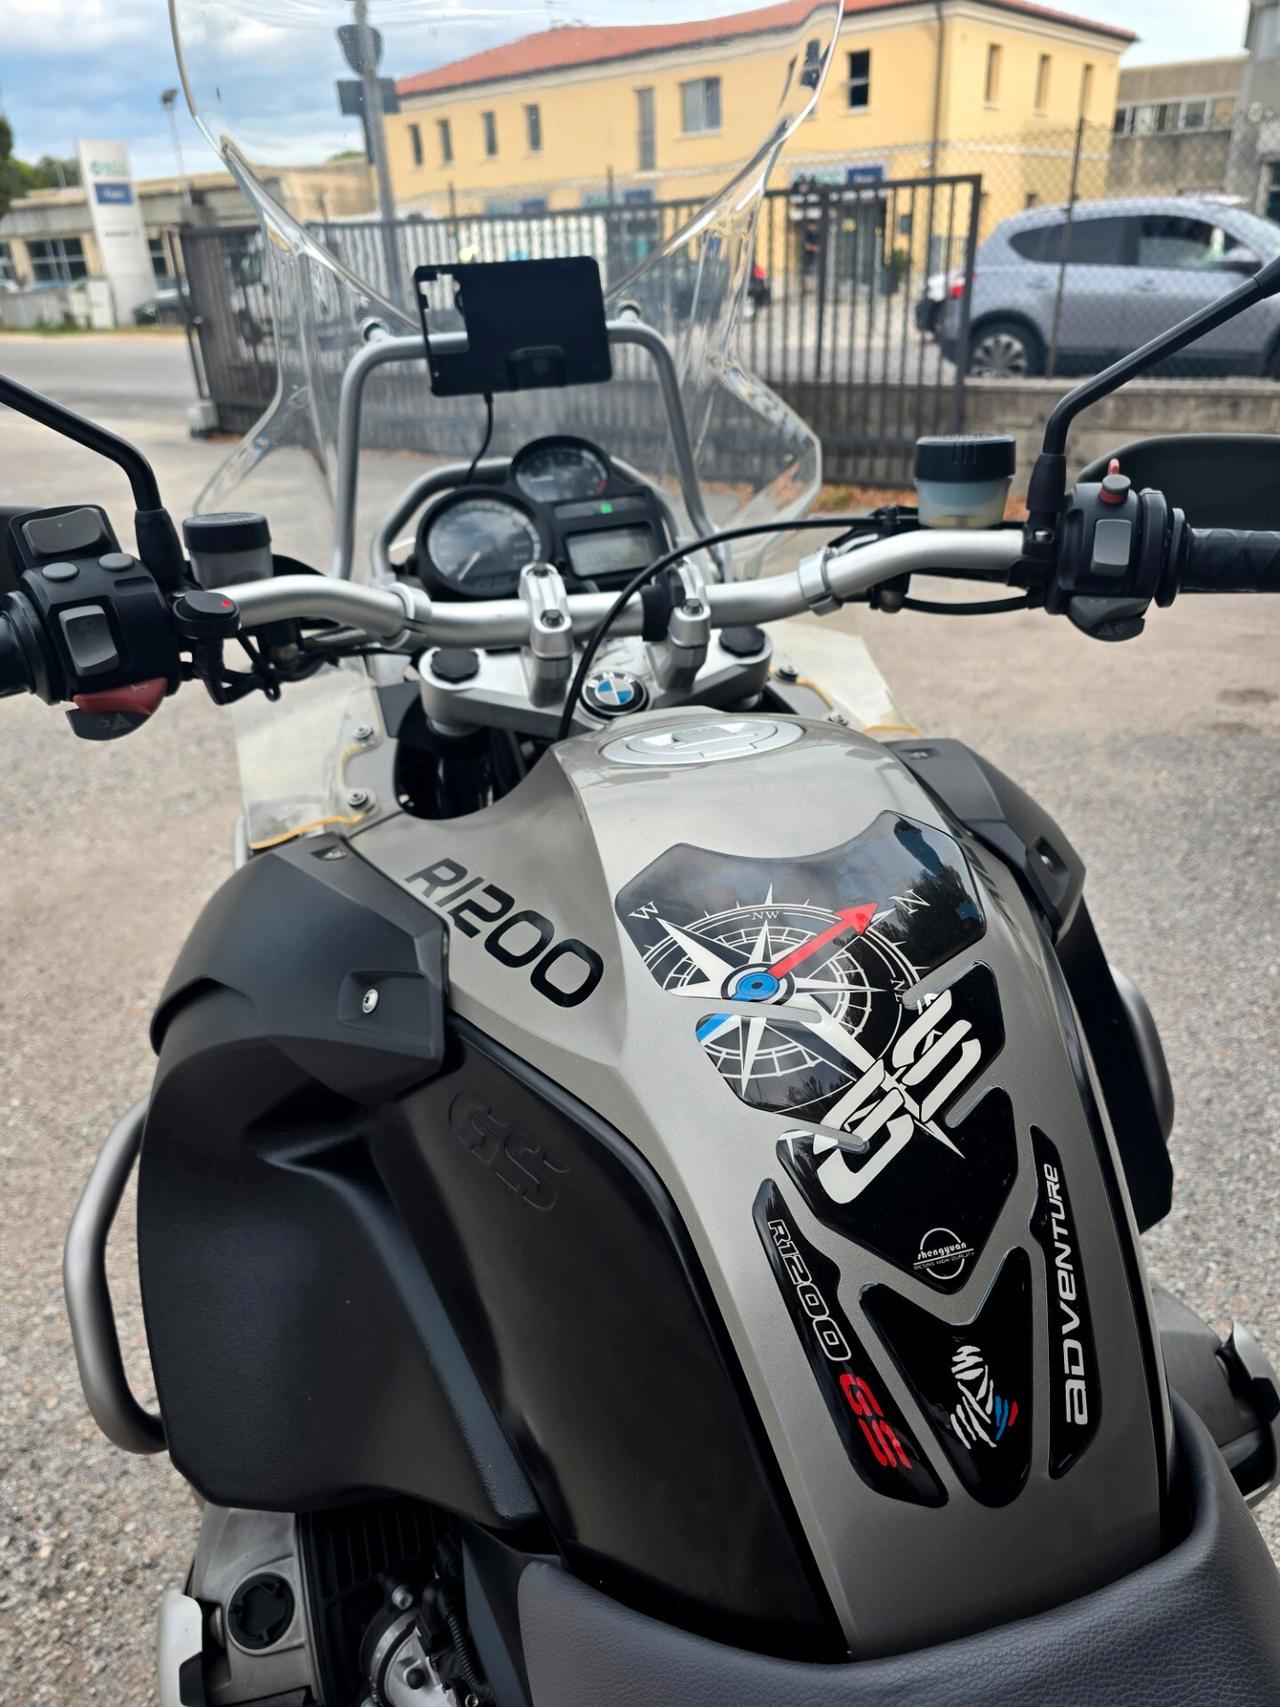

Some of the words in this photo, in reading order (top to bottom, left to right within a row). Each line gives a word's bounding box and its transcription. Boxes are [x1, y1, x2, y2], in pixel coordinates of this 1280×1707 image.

[627, 901, 659, 920] W
[888, 889, 931, 915] N
[752, 911, 780, 921] NW
[404, 858, 604, 1008] R1200
[917, 1242, 967, 1260] shengyuan
[840, 1373, 913, 1469] GS
